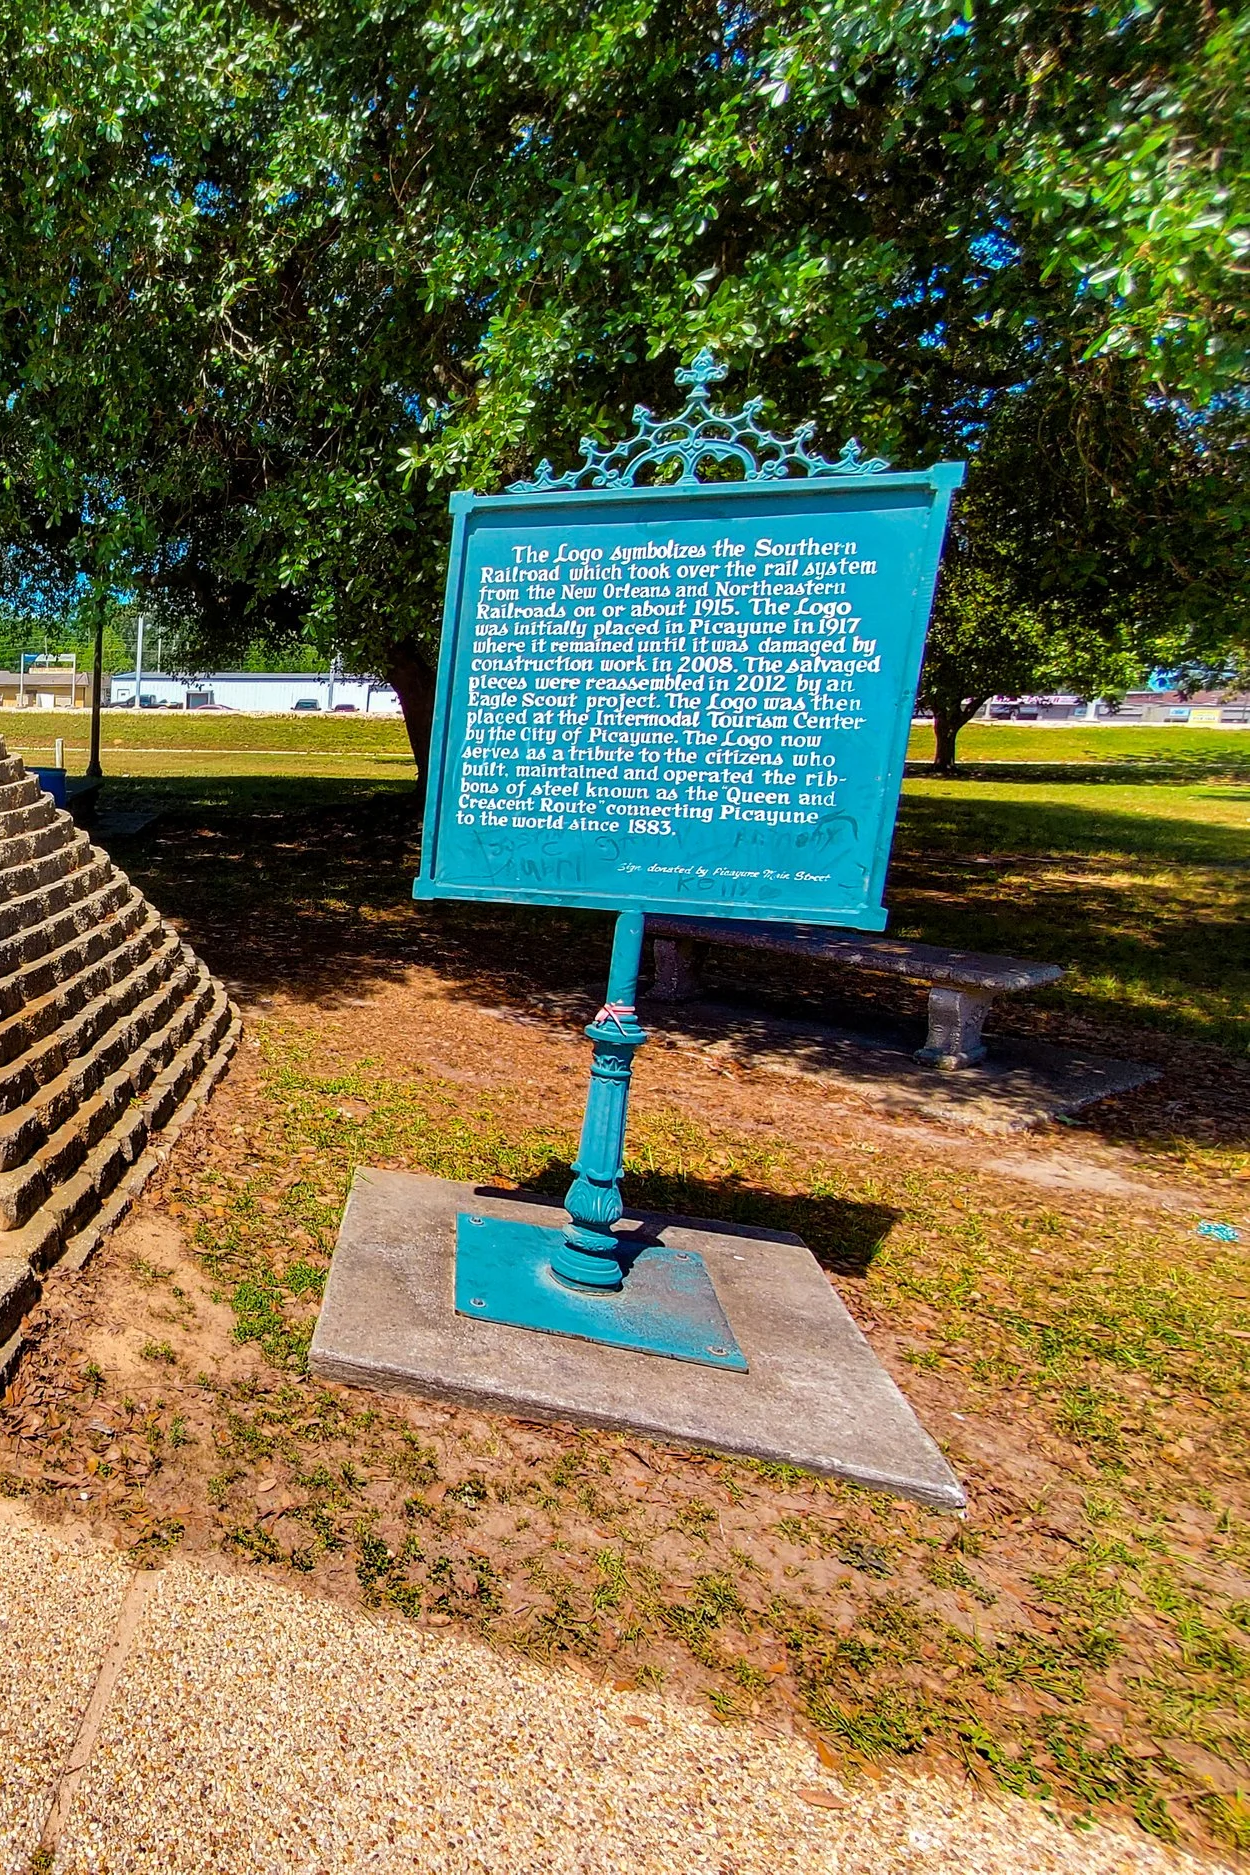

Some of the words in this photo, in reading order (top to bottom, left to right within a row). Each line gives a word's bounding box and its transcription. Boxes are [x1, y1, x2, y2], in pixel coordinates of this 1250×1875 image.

[512, 546, 549, 563] The
[553, 544, 603, 567] Logo
[610, 540, 706, 564] symbolizes
[712, 538, 745, 557] the
[755, 538, 856, 556] Southern
[481, 565, 559, 583] Railroad
[570, 563, 622, 581] which
[628, 563, 670, 579] took
[677, 565, 720, 578] over
[725, 560, 756, 577] the
[765, 559, 798, 576] rail
[803, 558, 877, 580] system
[477, 586, 519, 607] from
[527, 584, 555, 599] the
[561, 584, 596, 599] New
[603, 583, 670, 598] Orleans
[676, 582, 708, 597] and
[716, 580, 845, 596] Northeastern
[477, 602, 566, 619] Railroads
[574, 606, 595, 617] on
[603, 606, 626, 617] or
[631, 600, 686, 617] about
[693, 599, 739, 616] 1915.
[749, 598, 790, 615] The
[794, 598, 851, 620] Logo
[476, 624, 508, 636] was
[514, 620, 587, 638] initially
[594, 620, 659, 639] placed
[666, 620, 684, 634] in
[689, 619, 786, 638] Picayune
[794, 619, 814, 634] in
[818, 617, 861, 636] 1917
[474, 638, 525, 653] where
[532, 639, 546, 652] it
[551, 638, 633, 652] remained
[638, 637, 686, 652] until
[693, 637, 709, 652] it
[712, 640, 748, 652] was
[759, 637, 846, 657] damaged
[853, 636, 876, 657] by
[472, 655, 593, 671] construction
[601, 655, 648, 671] work
[653, 657, 672, 672] in
[677, 656, 738, 673] 2008.
[743, 657, 782, 673] The
[785, 656, 880, 676] salvaged
[469, 675, 527, 695] pieces
[536, 678, 580, 690] were
[586, 674, 704, 691] reassembled
[709, 676, 729, 691] in
[735, 675, 787, 692] 2012
[797, 674, 821, 698] by
[826, 679, 854, 692] an
[468, 691, 517, 709] Eagle
[522, 693, 577, 707] Scout
[586, 693, 660, 716] project.
[665, 693, 701, 709] The
[706, 693, 757, 714] Logo
[764, 697, 805, 711] was
[810, 694, 860, 711] then
[466, 709, 527, 730] placed
[534, 710, 554, 724] at
[557, 710, 588, 725] the
[596, 710, 700, 727] Intermodal
[707, 711, 788, 728] Tourism
[794, 712, 865, 729] Center
[465, 726, 484, 744] by
[488, 726, 516, 740] the
[521, 727, 556, 744] City
[562, 727, 582, 745] of
[588, 728, 678, 746] Picayune.
[683, 730, 717, 745] The
[721, 730, 772, 750] Logo
[781, 736, 821, 747] now
[462, 746, 519, 759] serves
[526, 748, 546, 760] as
[552, 749, 564, 760] a
[568, 746, 634, 761] tribute
[639, 748, 660, 762] to
[664, 748, 697, 763] the
[706, 749, 783, 765] citizens
[793, 752, 835, 767] who
[516, 764, 618, 779] maintained
[624, 766, 658, 780] and
[664, 769, 753, 784] operated
[762, 769, 795, 785] the
[806, 771, 846, 786] rib-
[461, 778, 498, 793] bons
[506, 780, 526, 798] of
[531, 781, 578, 796] steel
[586, 782, 649, 799] known
[657, 789, 677, 800] as
[686, 786, 718, 801] the
[799, 792, 834, 806] and
[459, 794, 534, 810] Crescent
[606, 803, 713, 822] connecting
[720, 805, 818, 825] Picayune
[456, 811, 474, 824] to
[480, 811, 508, 826] the
[512, 815, 563, 829] world
[569, 818, 619, 832] since
[629, 820, 675, 835] 1883.
[648, 864, 693, 873] donated
[696, 867, 708, 877] by
[795, 872, 830, 881] Street
